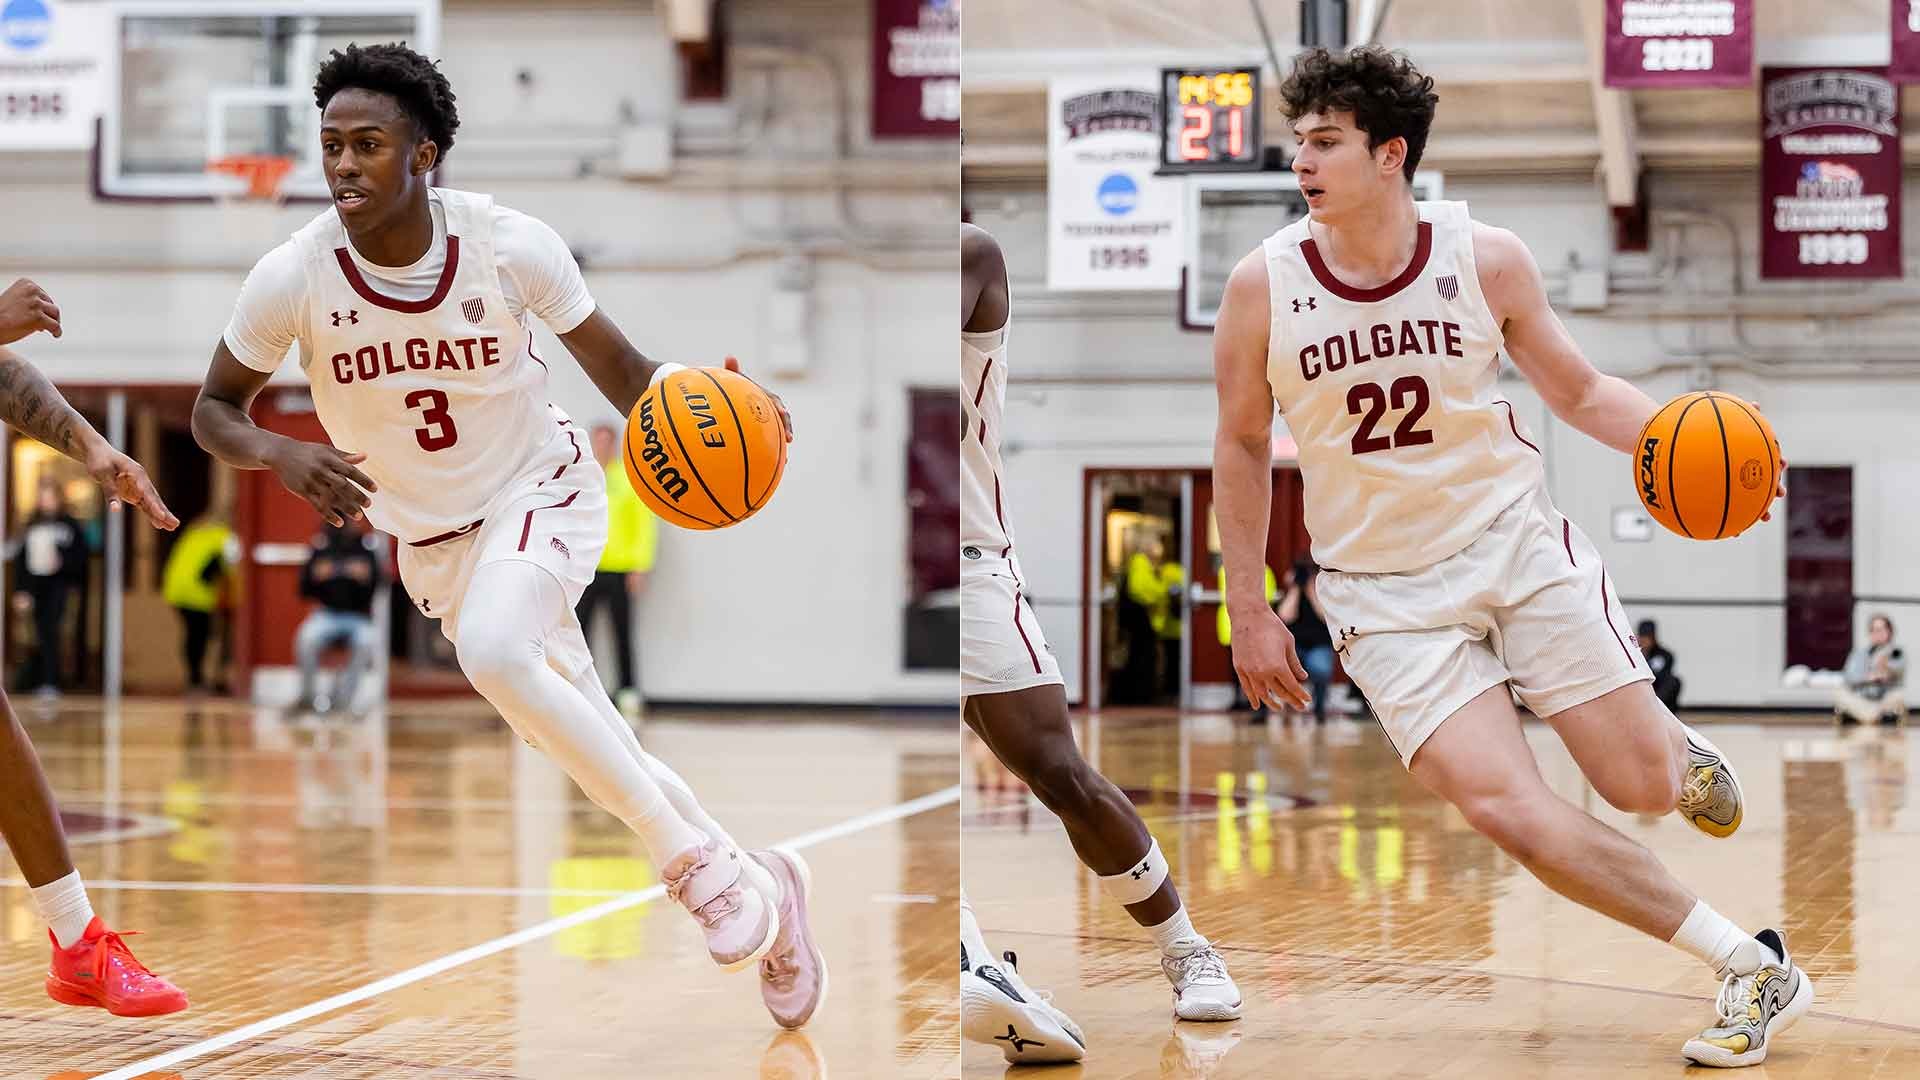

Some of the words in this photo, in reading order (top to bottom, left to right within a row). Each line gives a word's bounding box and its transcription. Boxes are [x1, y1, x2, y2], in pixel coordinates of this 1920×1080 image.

[1642, 38, 1713, 70] 2021
[1179, 73, 1252, 106] 14:56
[1180, 106, 1243, 160] 21
[1091, 245, 1149, 268] 1996
[1798, 233, 1869, 264] 1999
[331, 336, 501, 384] COLGATE
[1299, 319, 1464, 381] COLGATE
[404, 388, 458, 452] 3
[1346, 375, 1434, 455] 22
[639, 395, 689, 503] Wilson
[1640, 438, 1662, 509] NCAA
